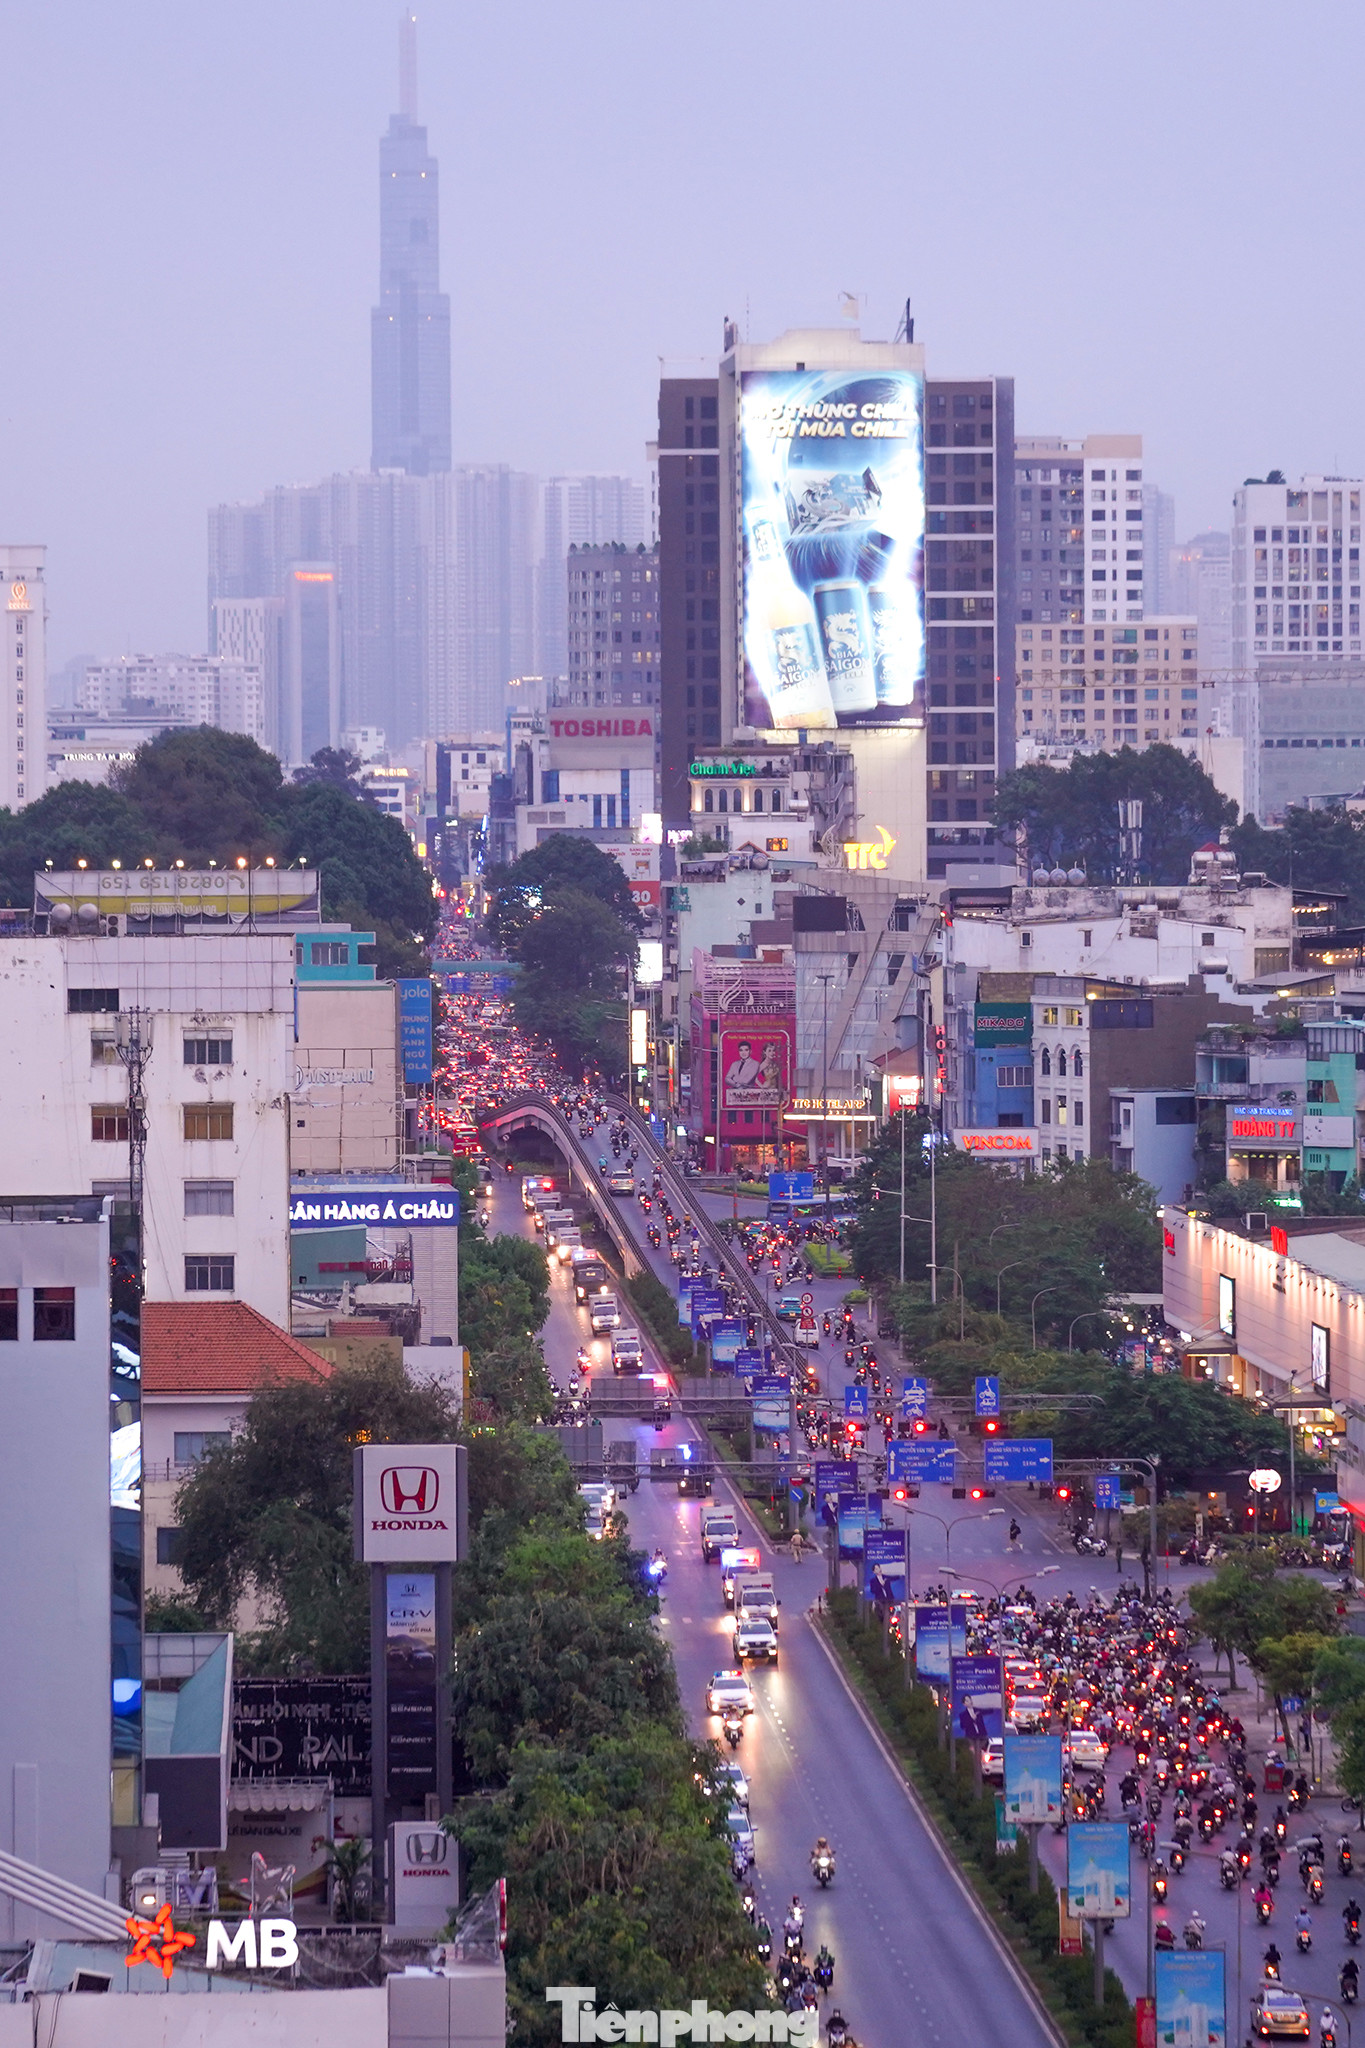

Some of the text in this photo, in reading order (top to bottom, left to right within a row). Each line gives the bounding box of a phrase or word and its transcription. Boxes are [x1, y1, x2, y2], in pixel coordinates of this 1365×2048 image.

[788, 400, 857, 419] THÙNG
[800, 417, 846, 437] MÙA
[851, 421, 909, 438] CHILL
[550, 719, 653, 738] TOSHIBA
[64, 753, 94, 761] TRUNG
[731, 763, 756, 777] Việt
[843, 843, 887, 870] TTC
[101, 876, 225, 889] 0828 159 159
[631, 890, 651, 903] 30
[400, 985, 429, 1001] yola
[733, 1005, 780, 1014] CHARME
[400, 1015, 429, 1023] TRUNG
[977, 1018, 1025, 1028] MIKADO
[404, 1025, 425, 1035] TÂM
[935, 1025, 947, 1093] HOTEL
[1232, 1117, 1295, 1138] HOÀNG TY
[962, 1135, 1033, 1150] VINCOM
[324, 1200, 380, 1220] HÀNG
[383, 1199, 397, 1220] Á
[399, 1199, 453, 1219] CHÂU
[371, 1520, 448, 1531] HONDA
[260, 1701, 289, 1720] HỘI
[402, 1869, 450, 1877] HONDA
[206, 1918, 299, 1969] MB
